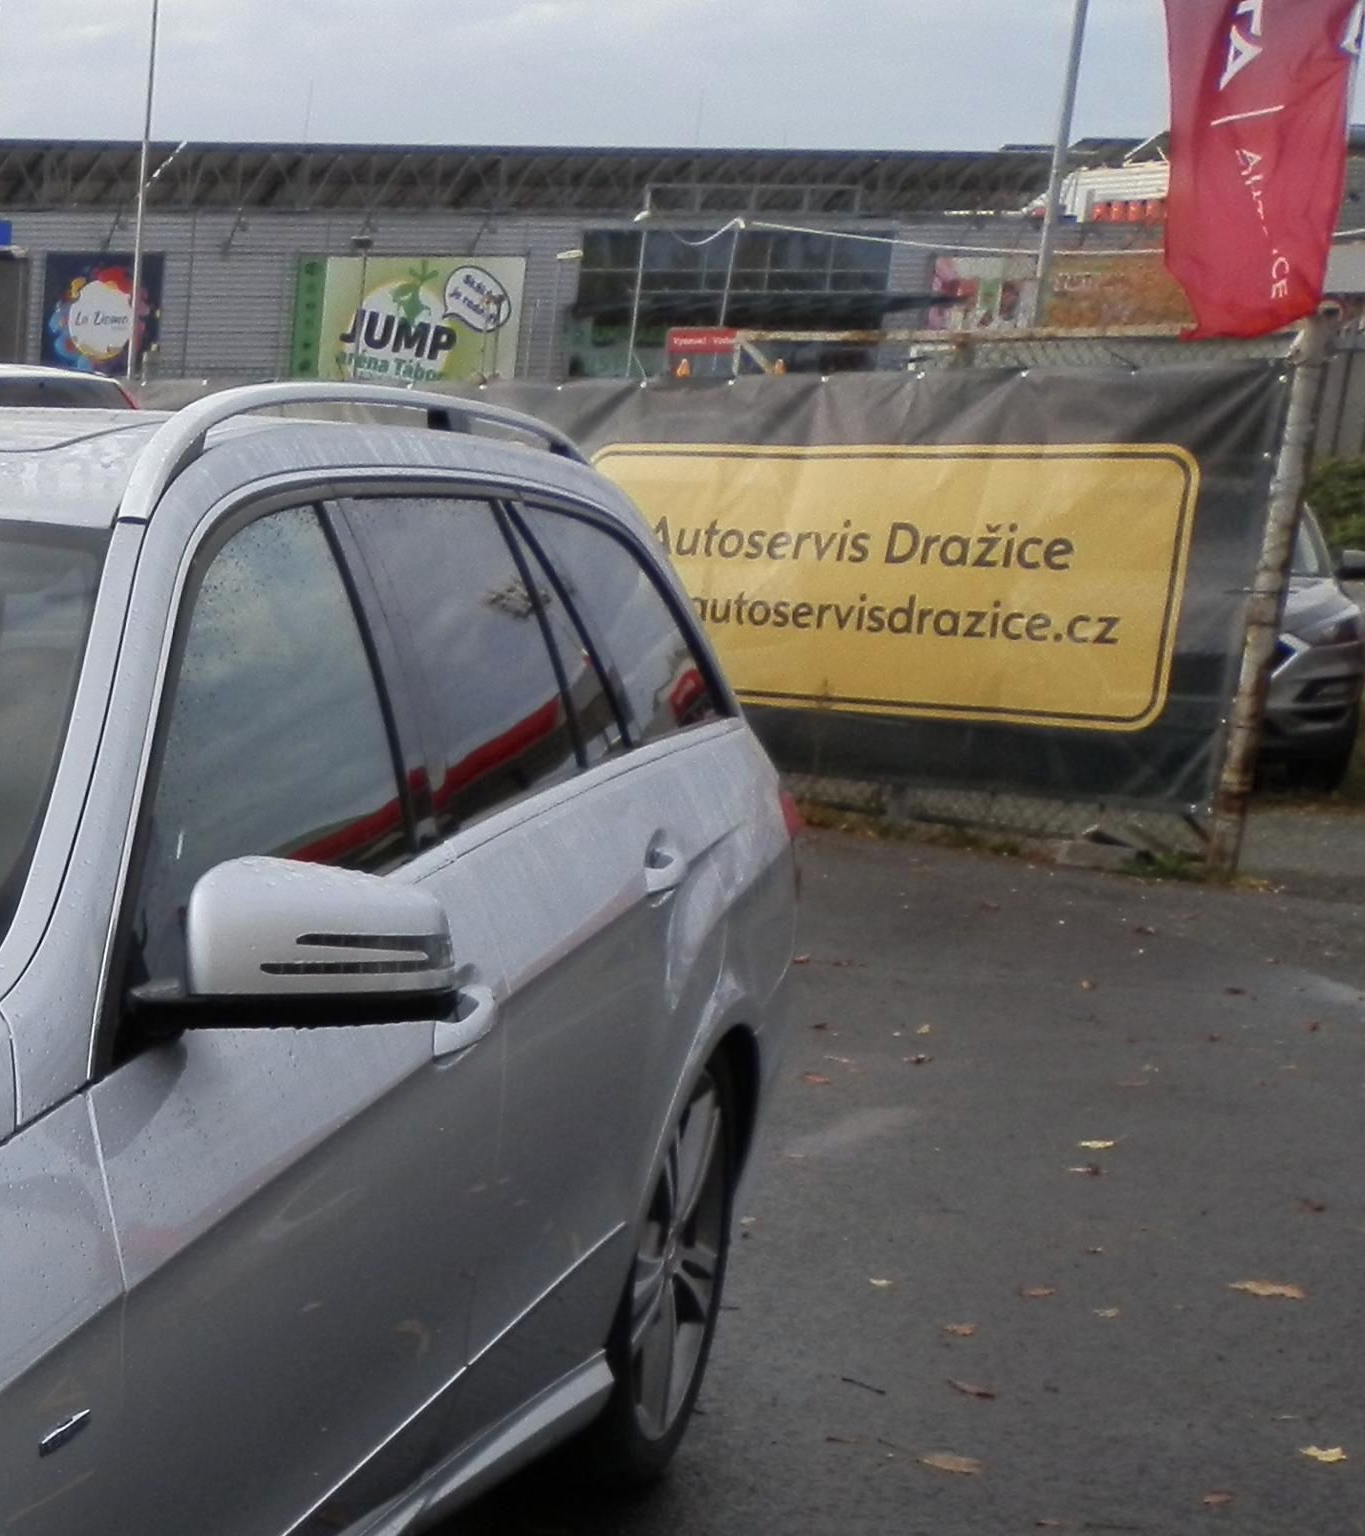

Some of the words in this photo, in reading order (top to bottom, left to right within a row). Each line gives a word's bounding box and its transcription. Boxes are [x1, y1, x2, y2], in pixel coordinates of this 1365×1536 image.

[340, 309, 457, 361] JUMP
[653, 515, 870, 563] Autoservis
[884, 521, 1074, 572] Dražice
